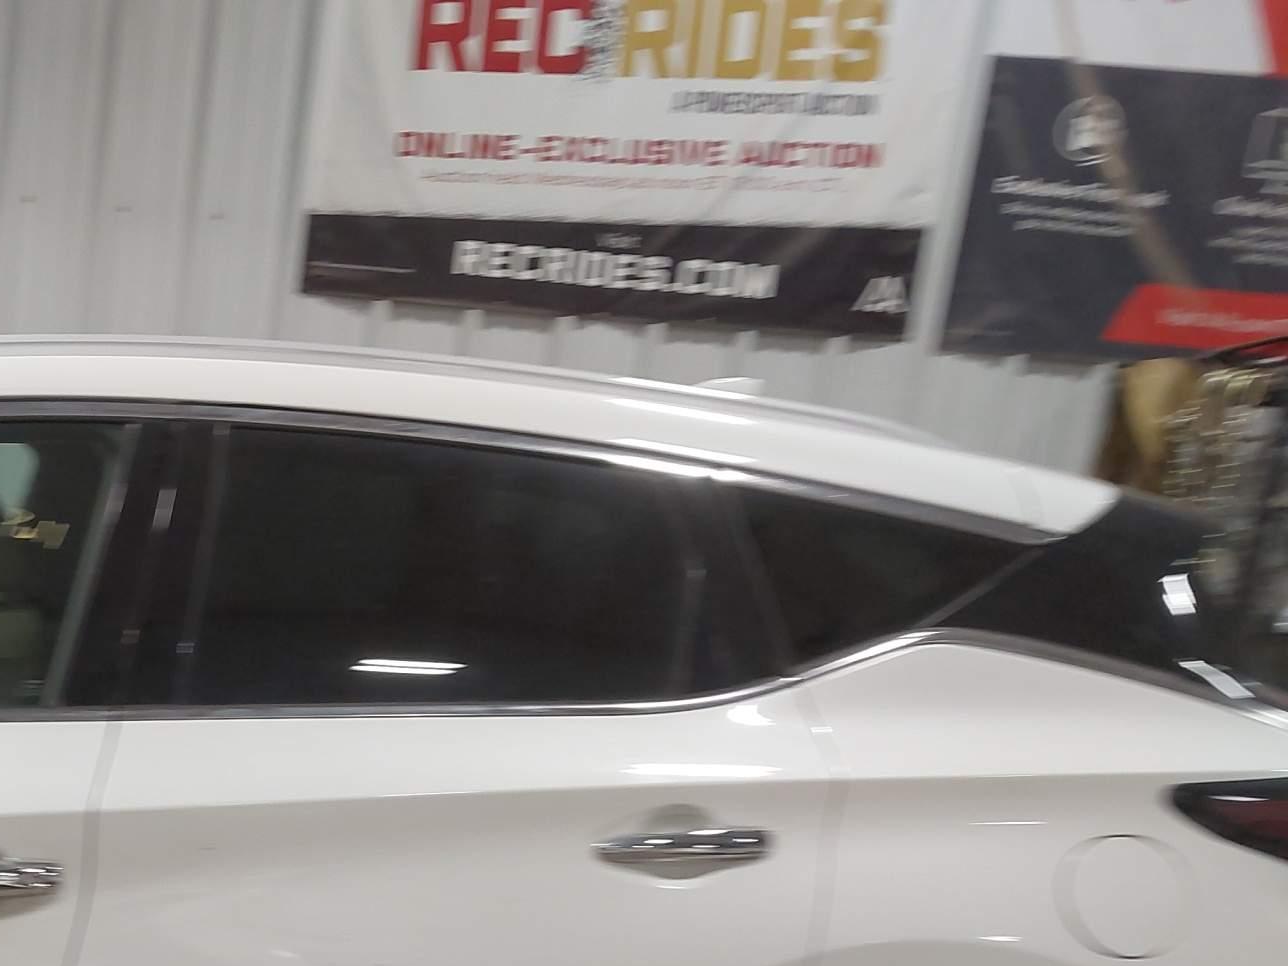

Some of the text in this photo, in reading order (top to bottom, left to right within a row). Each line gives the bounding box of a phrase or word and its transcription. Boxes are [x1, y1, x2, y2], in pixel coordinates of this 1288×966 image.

[412, 0, 594, 75] REC
[619, 0, 882, 83] RIDES
[396, 131, 885, 169] ONLINE-EXCLUSIVE AUCTION
[451, 239, 780, 299] RECRIDES.COM
